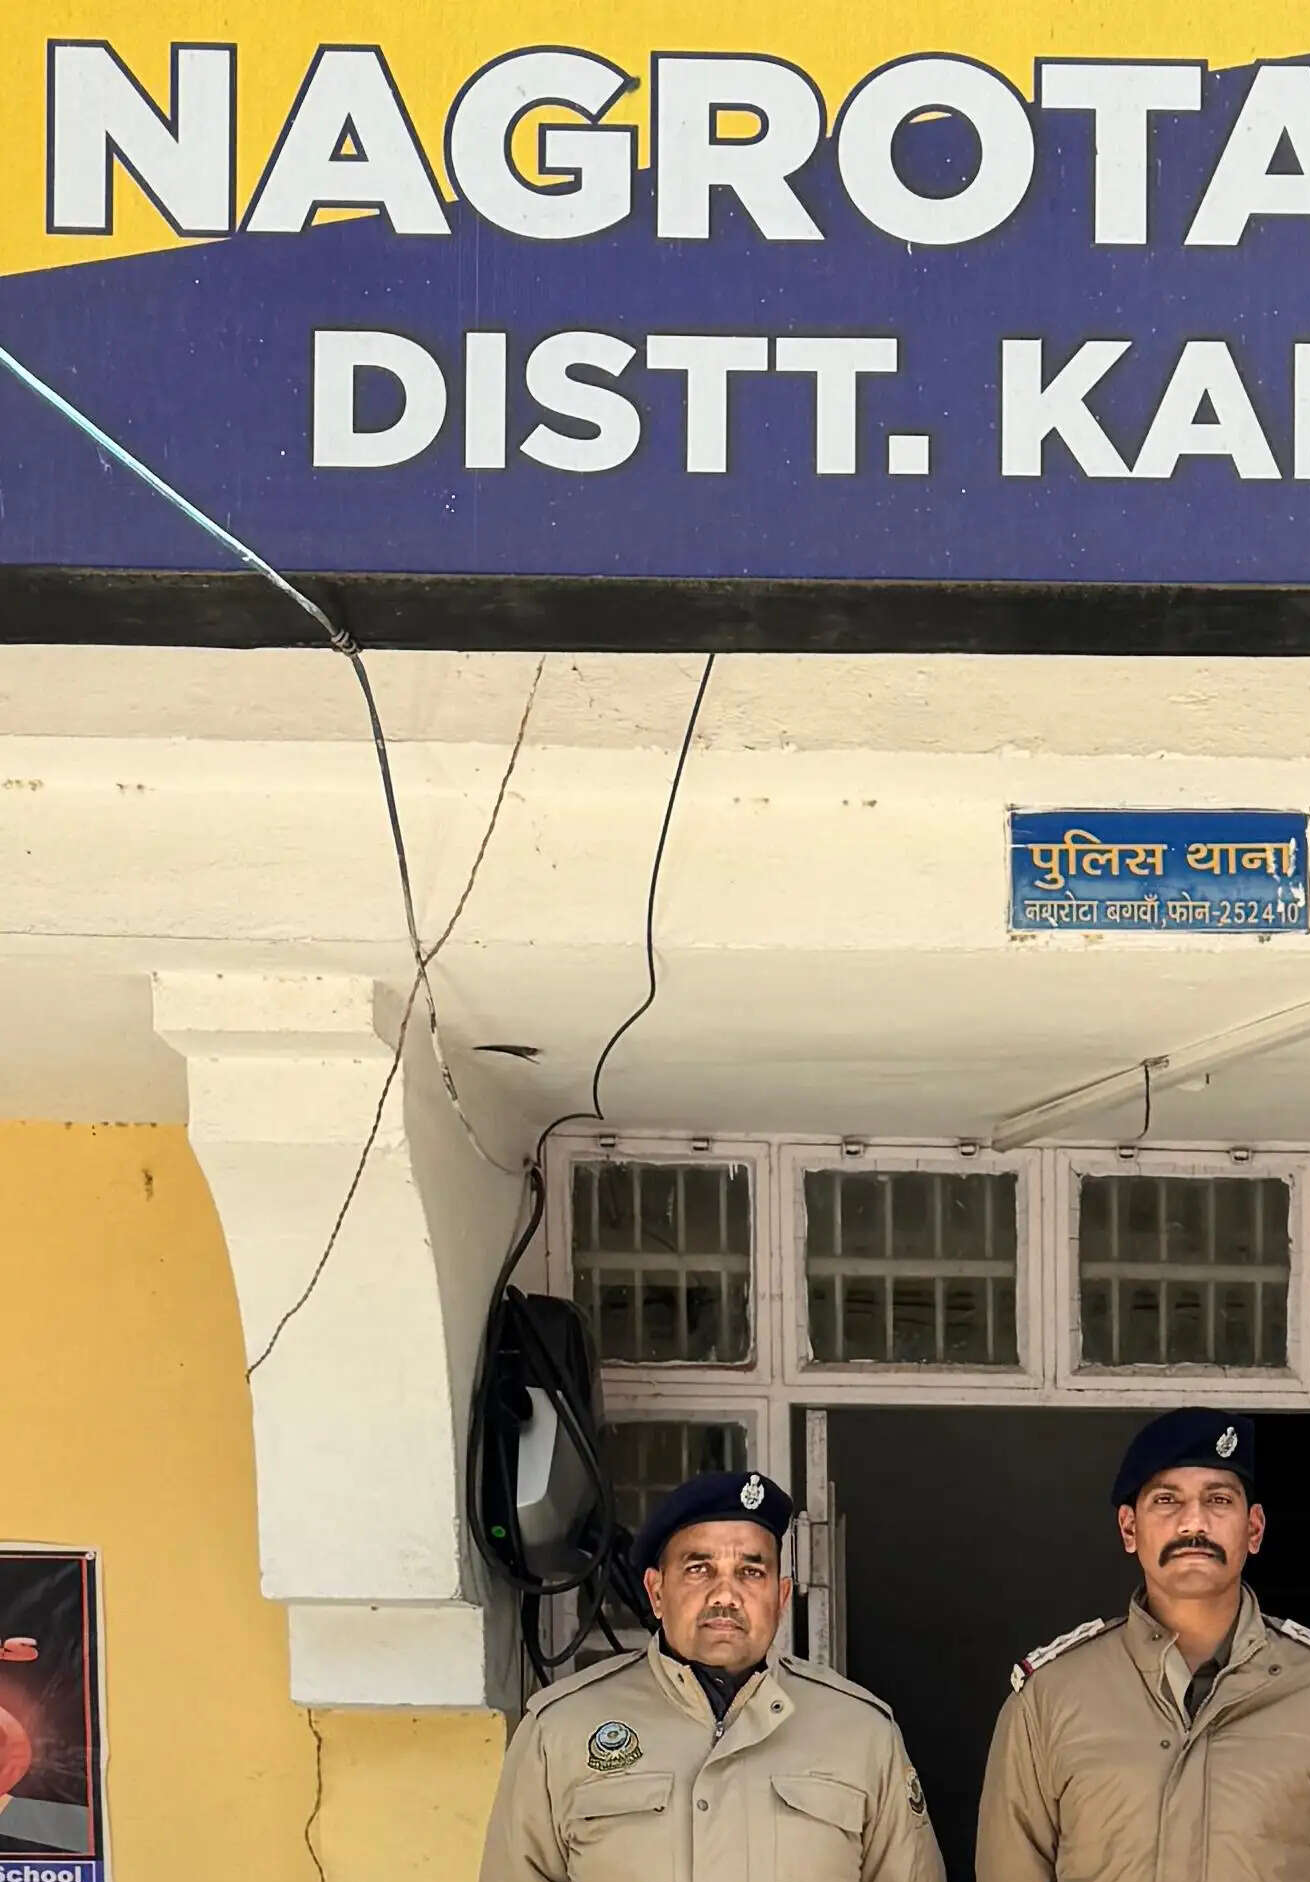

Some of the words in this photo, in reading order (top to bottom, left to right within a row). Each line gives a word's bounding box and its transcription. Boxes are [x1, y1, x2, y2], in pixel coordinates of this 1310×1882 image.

[313, 330, 930, 475] DISTT.
[1028, 828, 1168, 890] पुलिस
[1186, 842, 1292, 877] थाना
